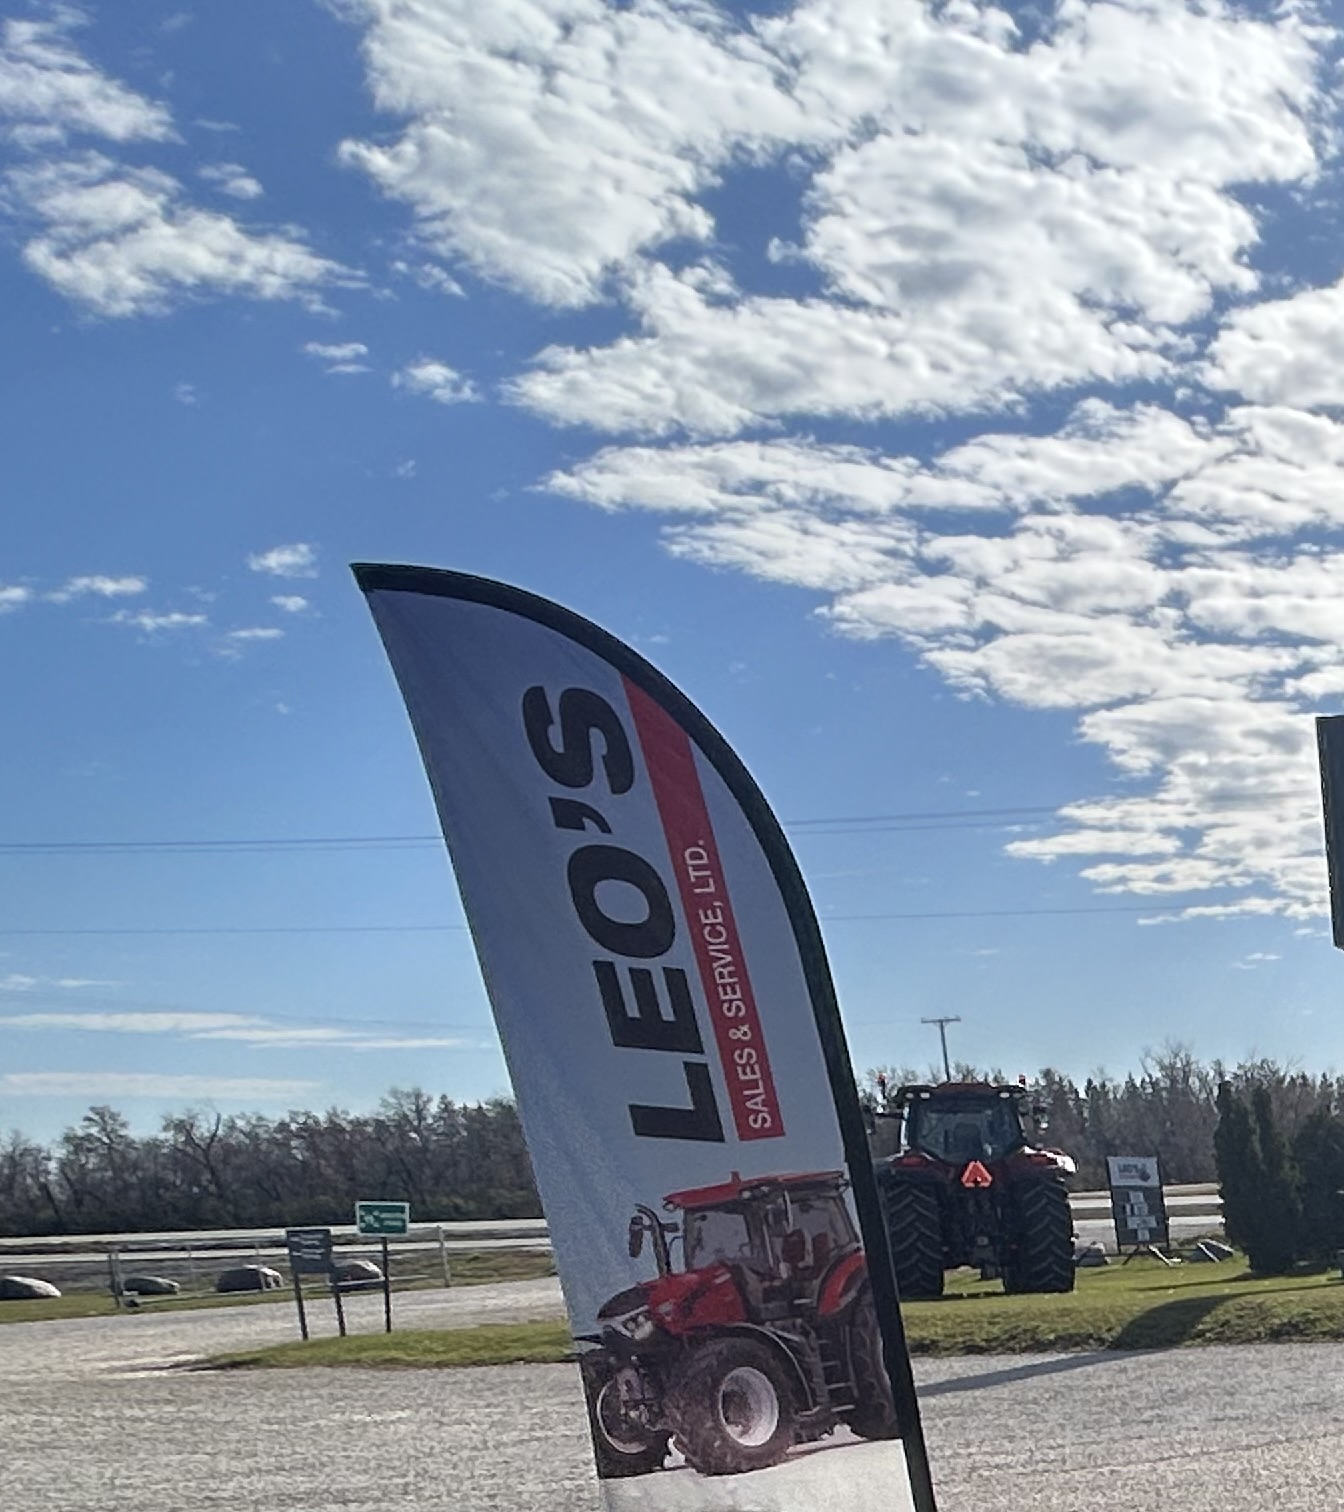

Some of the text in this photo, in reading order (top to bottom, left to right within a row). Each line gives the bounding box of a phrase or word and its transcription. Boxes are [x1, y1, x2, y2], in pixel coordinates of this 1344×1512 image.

[522, 685, 726, 1143] LEO'S
[684, 839, 772, 1129] SALES & SERVICE, LTD.
